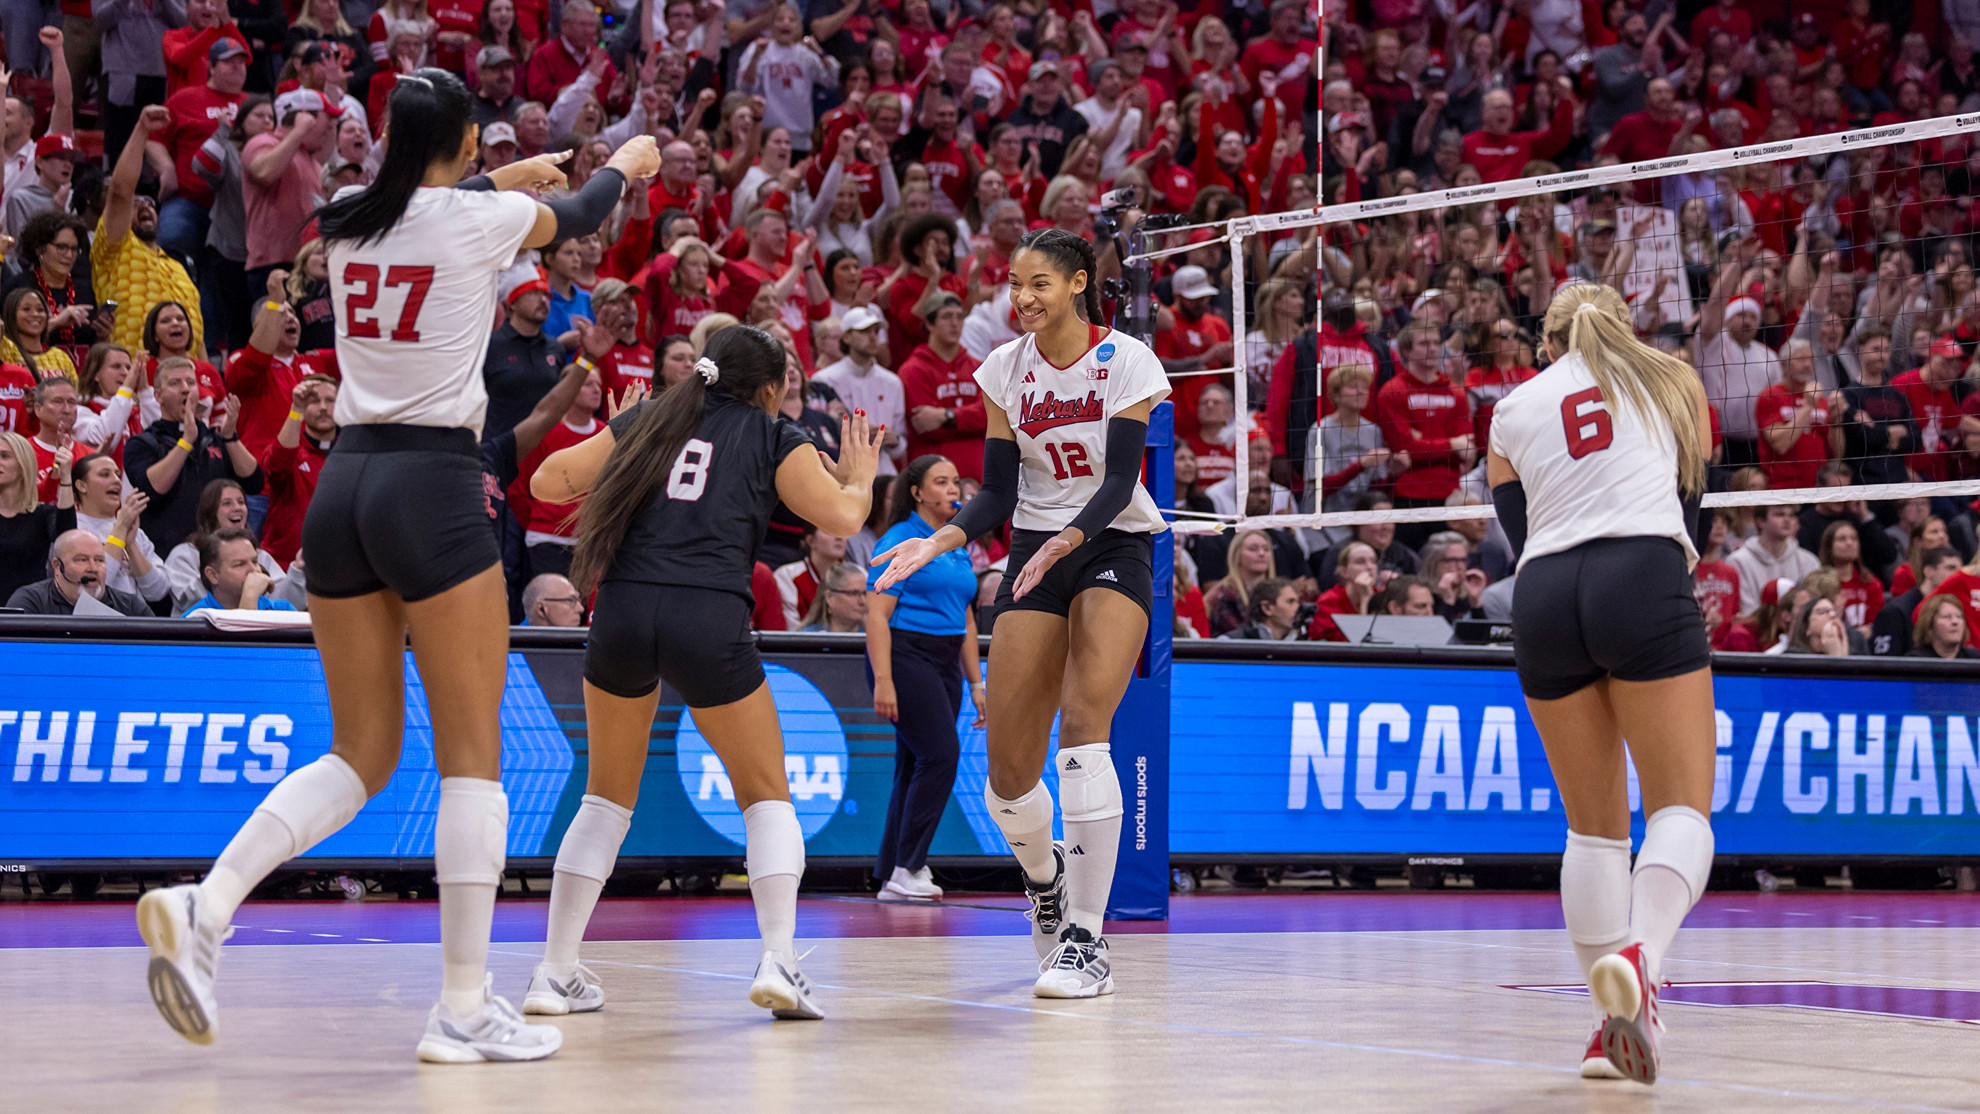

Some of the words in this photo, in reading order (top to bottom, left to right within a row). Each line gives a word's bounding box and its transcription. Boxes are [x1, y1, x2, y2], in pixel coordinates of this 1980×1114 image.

[1740, 148, 1762, 158] VOLLEYBALL
[1763, 144, 1793, 155] CHAMPIONSHIP
[1848, 132, 1872, 142] VOLLEYBALL
[1873, 127, 1905, 139] CHAMPIONSHIP
[1542, 177, 1562, 186] VOLLEYBALL
[1637, 162, 1659, 172] VOLLEYBALL
[1659, 159, 1688, 169] CHAMPIONSHIP
[343, 262, 435, 342] 27
[1560, 386, 1614, 461] 6
[666, 438, 713, 502] 8
[1045, 442, 1094, 481] 12
[1874, 635, 1892, 654] 25
[699, 755, 842, 801] NAA
[1065, 763, 1082, 771] adidas
[1135, 756, 1148, 798] sports
[1135, 799, 1147, 851] imports
